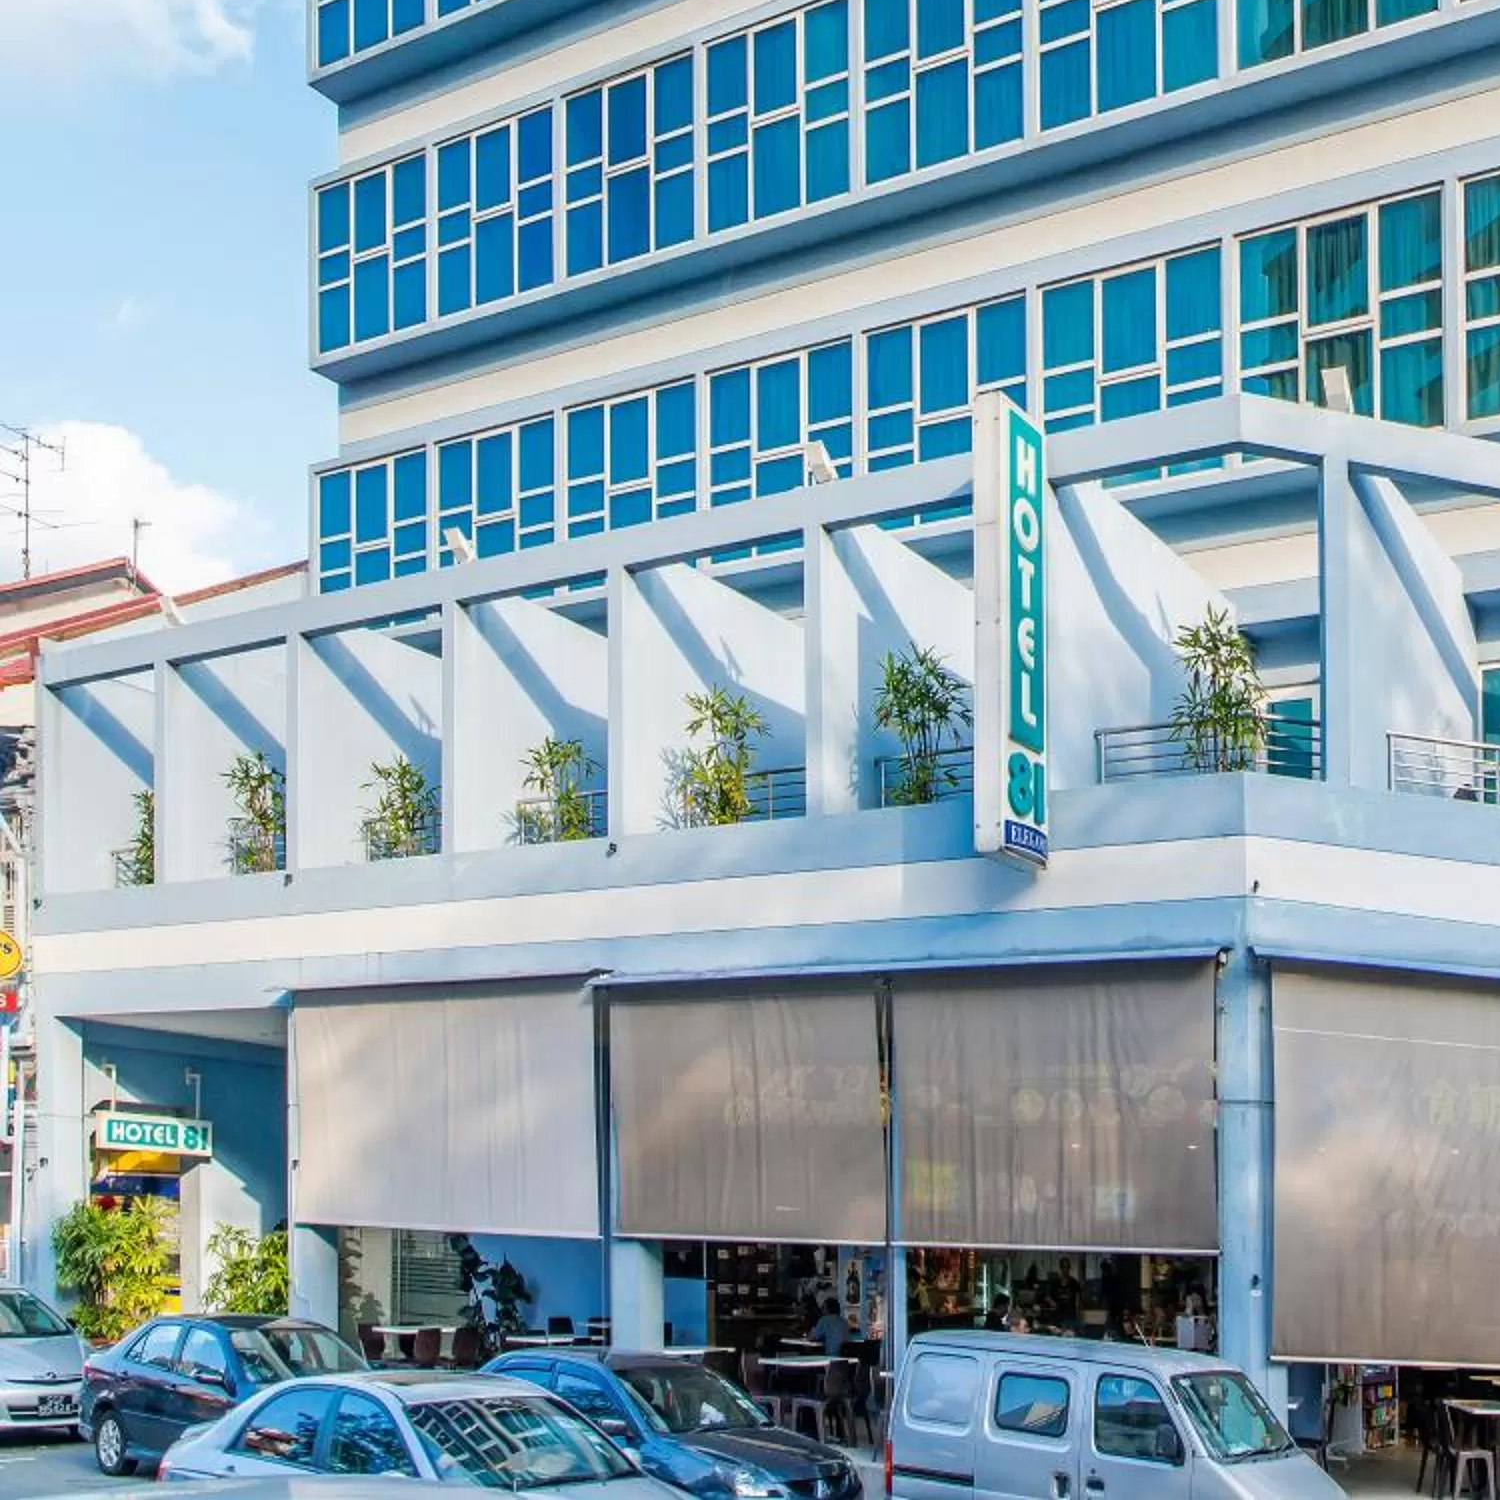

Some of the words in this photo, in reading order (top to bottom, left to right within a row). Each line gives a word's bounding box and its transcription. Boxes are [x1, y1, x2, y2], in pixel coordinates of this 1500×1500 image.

[1013, 436, 1040, 727] HOTEL
[1008, 752, 1045, 825] 81
[112, 1122, 176, 1145] HOTEL
